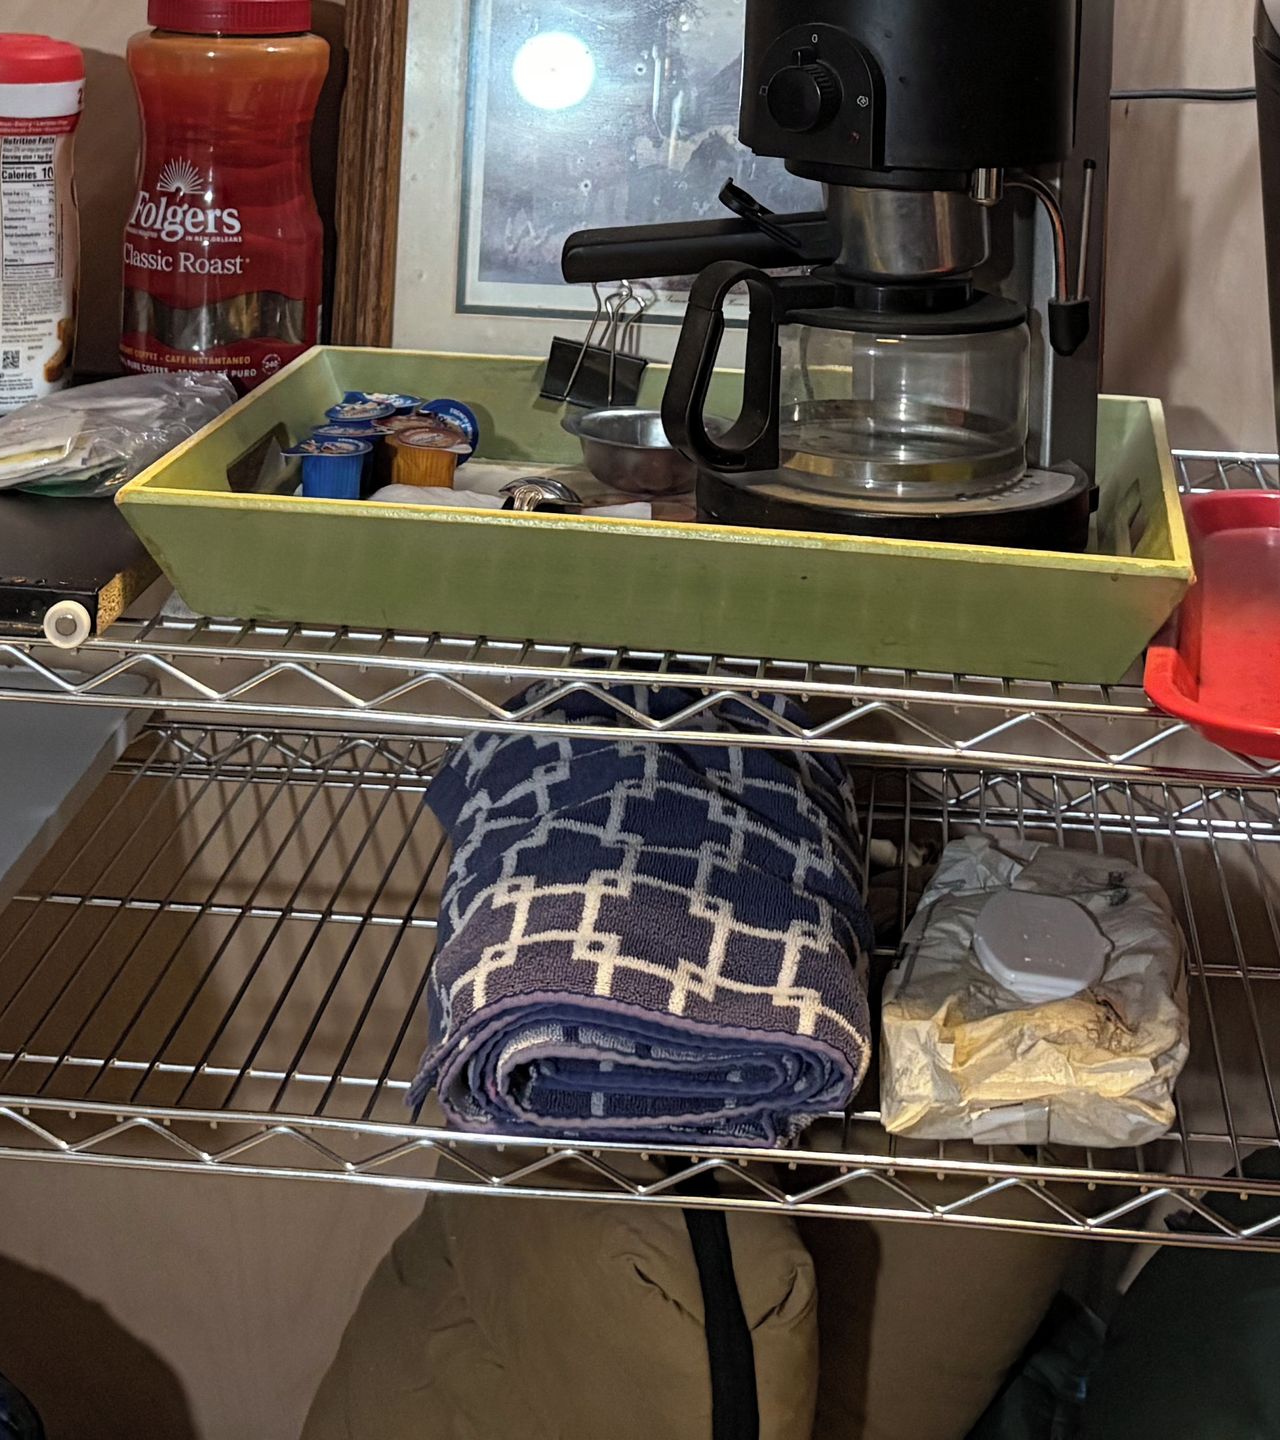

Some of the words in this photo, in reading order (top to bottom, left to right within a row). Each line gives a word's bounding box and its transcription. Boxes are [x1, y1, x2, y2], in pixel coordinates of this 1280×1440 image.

[3, 137, 36, 145] Nutrition
[1, 169, 37, 180] Calories
[41, 166, 54, 179] 10
[129, 191, 242, 242] Folgers
[123, 242, 173, 272] Classic
[178, 252, 244, 275] Roast
[231, 369, 257, 378] PURO
